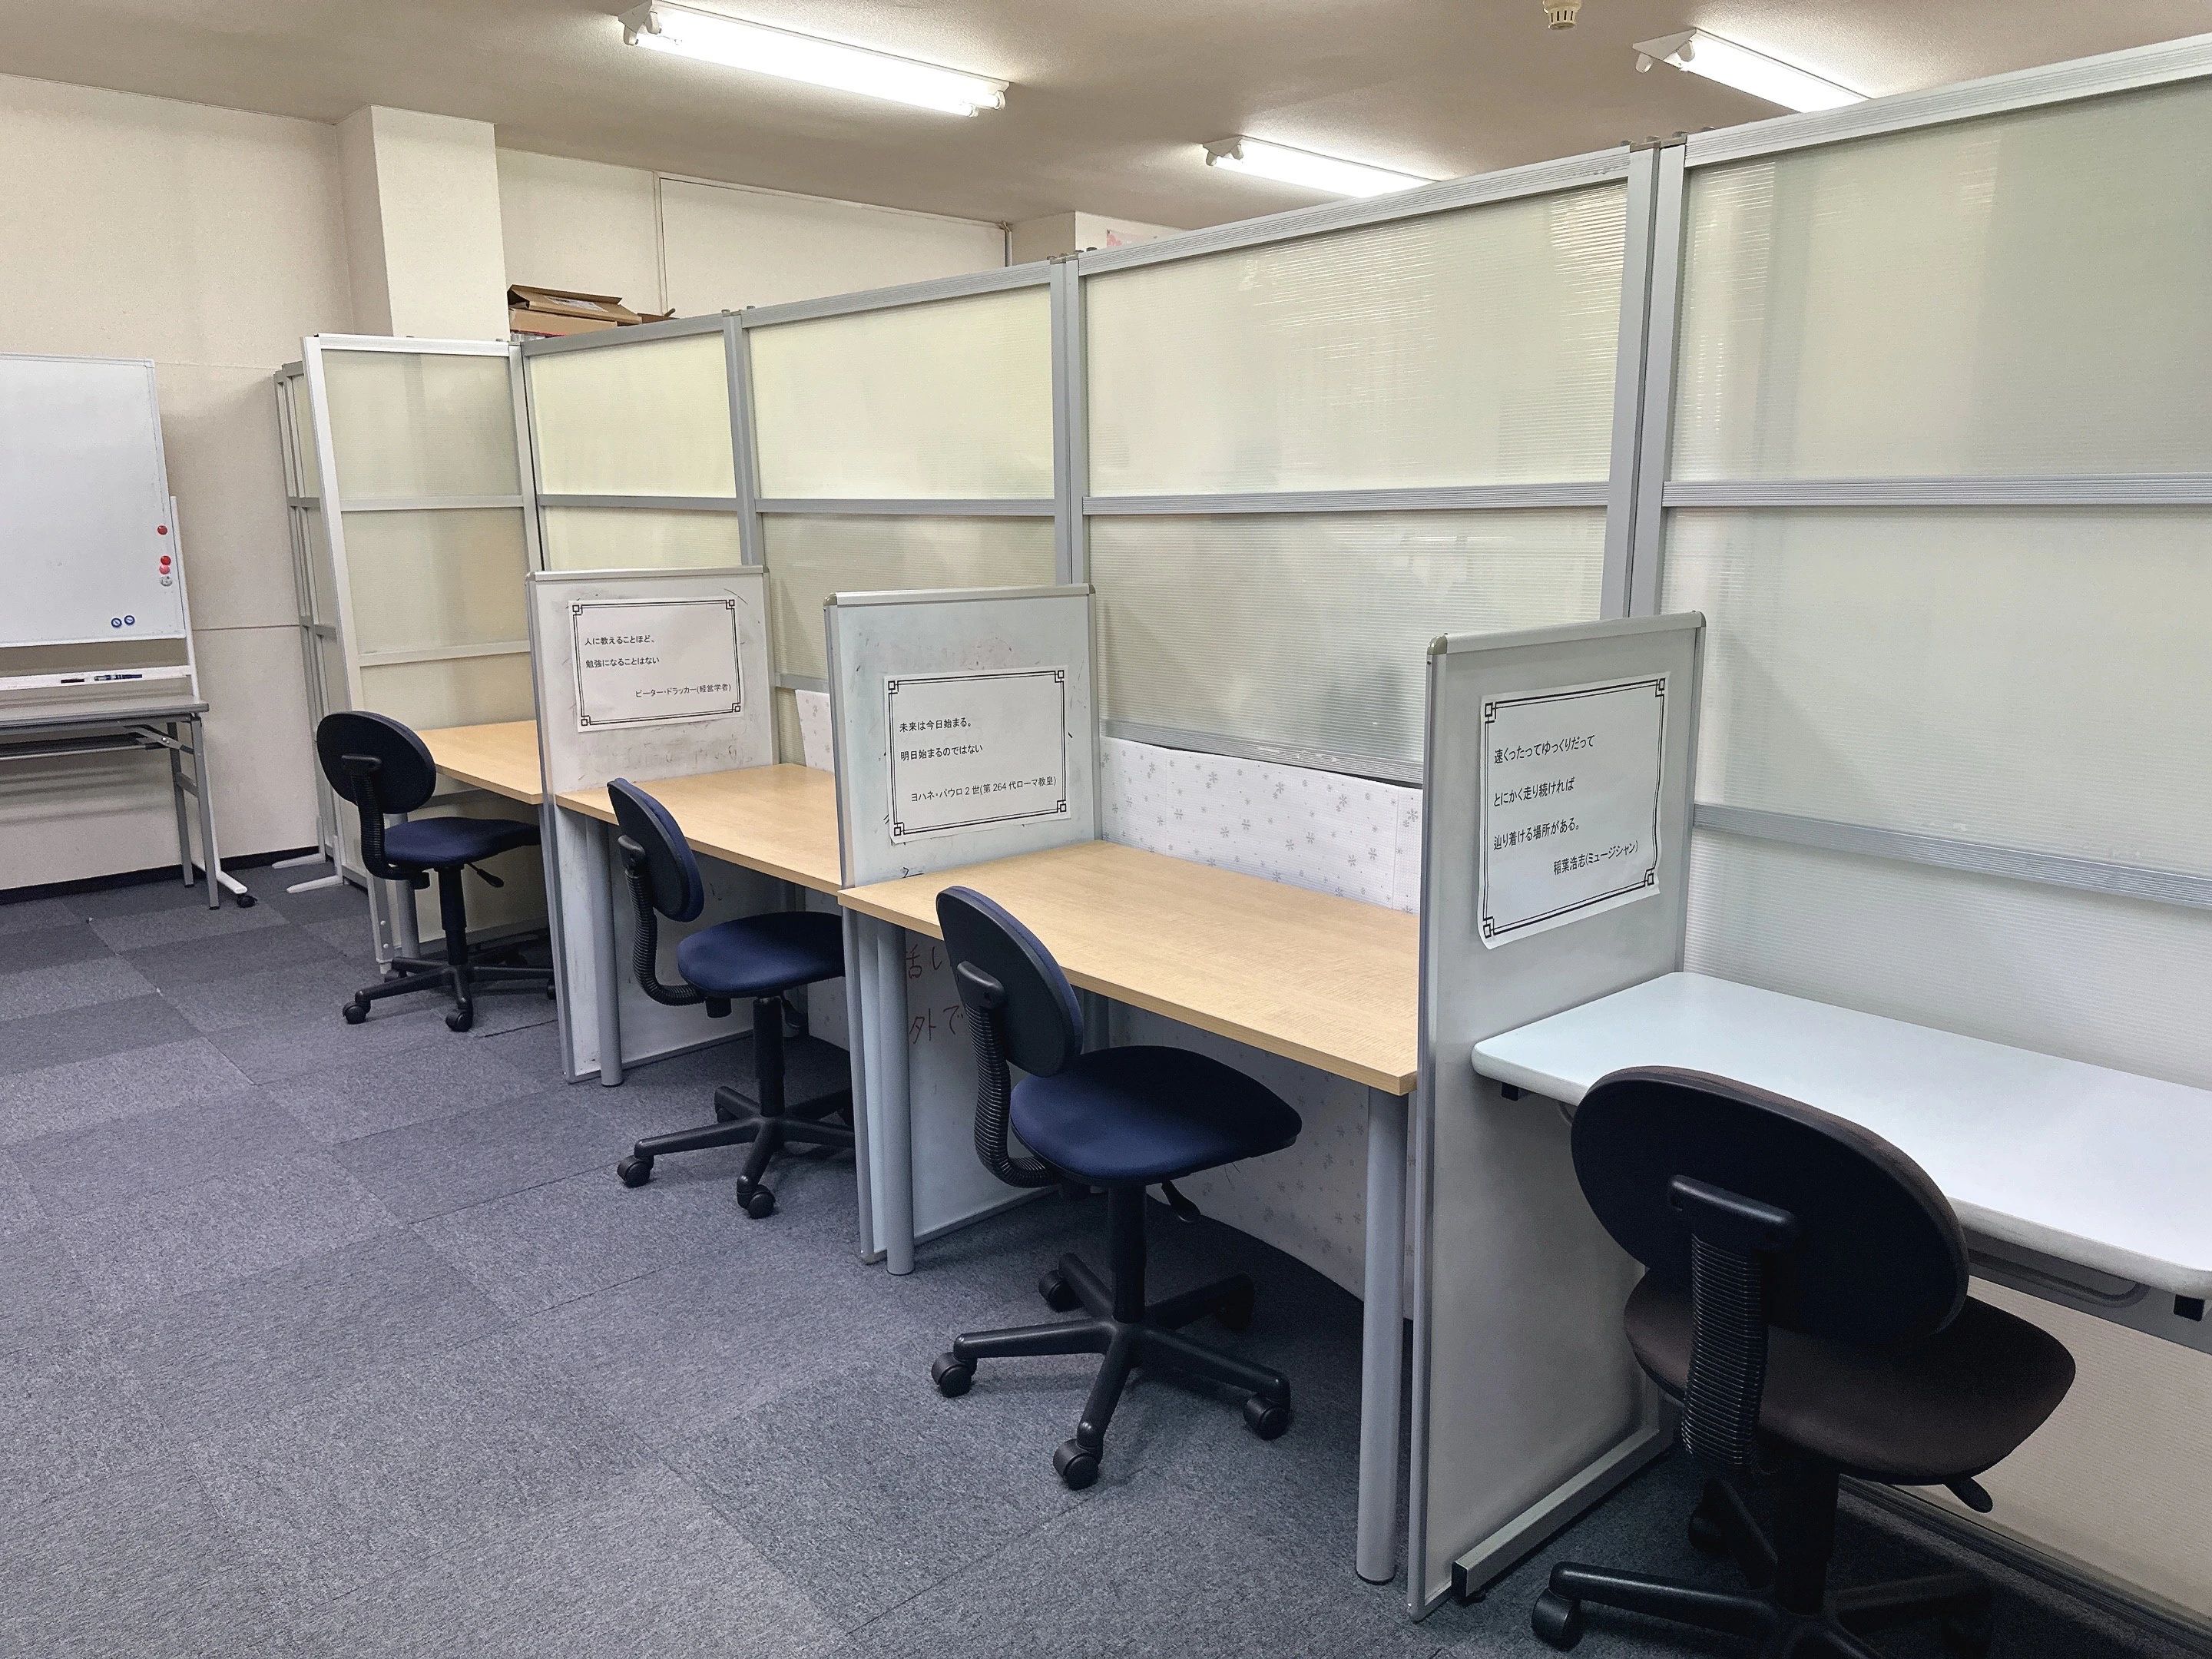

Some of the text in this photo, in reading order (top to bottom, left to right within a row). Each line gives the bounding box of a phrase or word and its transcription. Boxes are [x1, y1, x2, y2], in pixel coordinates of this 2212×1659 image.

[584, 635, 654, 646] 人に教えることほど、
[585, 657, 660, 668] 勉強になることはない
[635, 684, 731, 697] ピーター・ドラッカー(経営学者)
[899, 717, 972, 733] 未来は今日始まる。
[900, 744, 983, 761] 明日始まるのではない
[1494, 735, 1595, 763] 速くったってゆっくりだって
[1494, 777, 1575, 807] とにかく走り続ければ
[1494, 817, 1579, 850] 辿り着ける場所がある。
[1553, 840, 1638, 875] 稲葉浩志(ミュージシャン)
